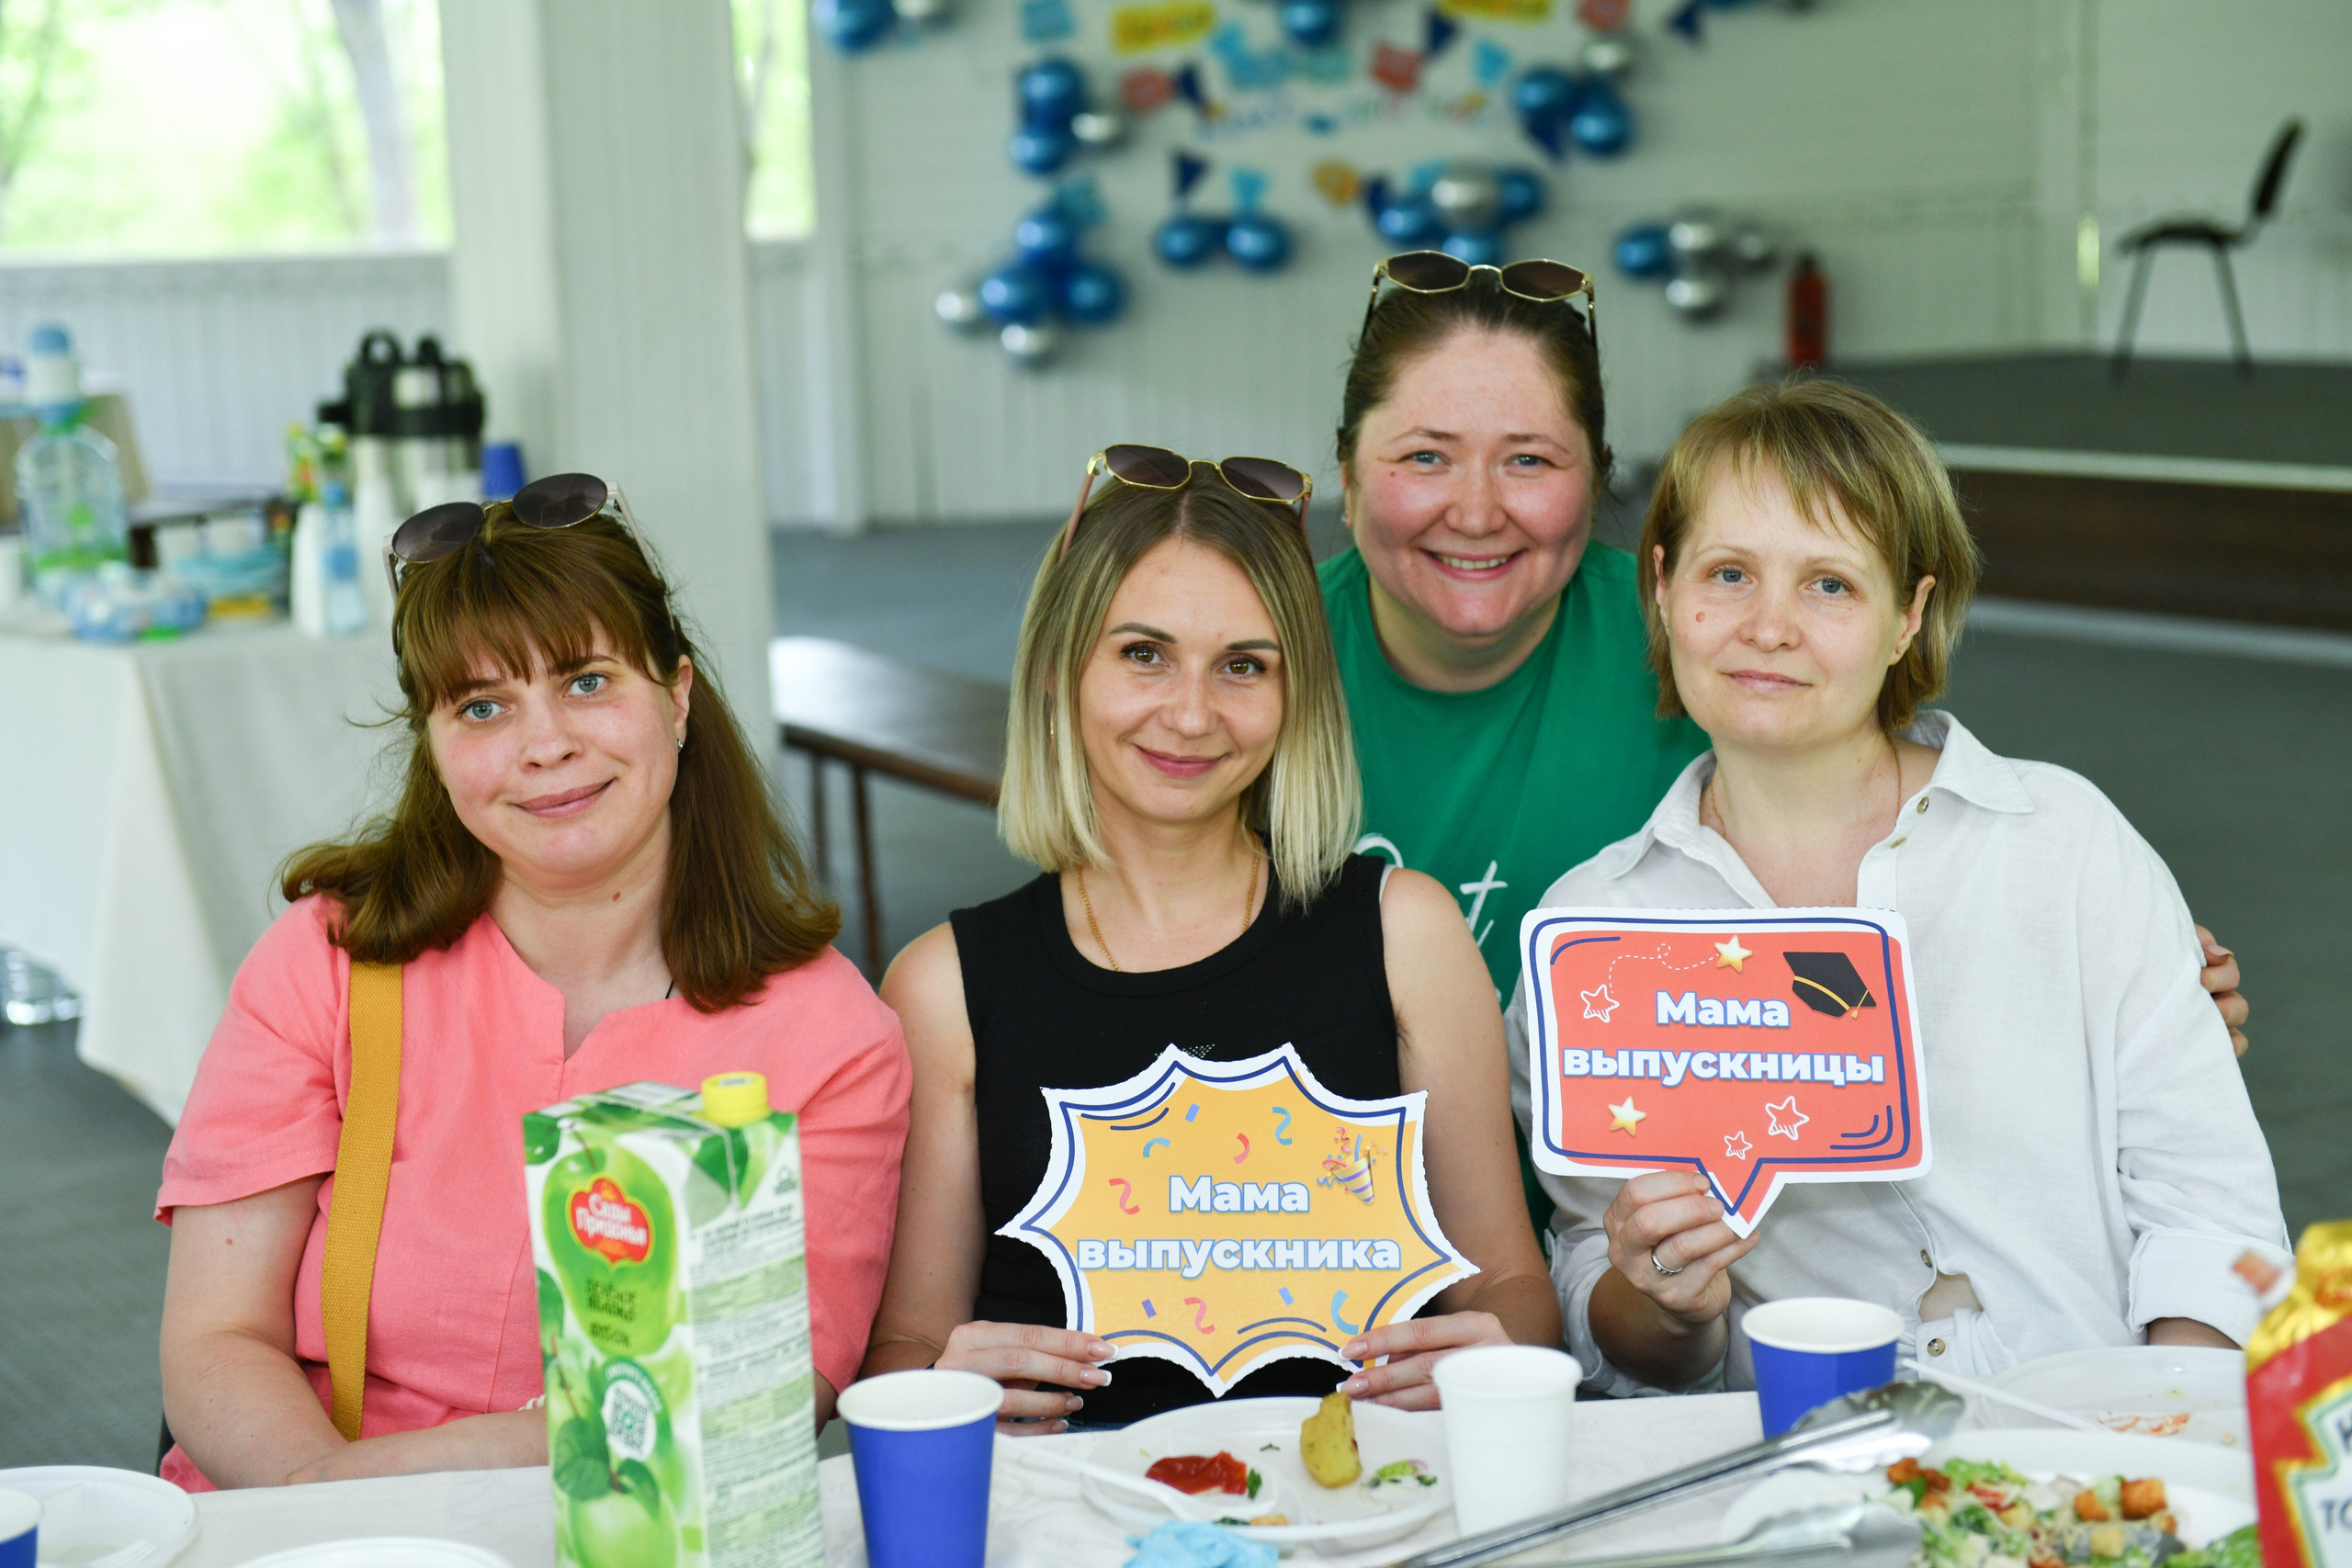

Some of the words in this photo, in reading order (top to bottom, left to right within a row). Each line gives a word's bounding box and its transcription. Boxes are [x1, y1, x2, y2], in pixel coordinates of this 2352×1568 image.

[1657, 990, 1791, 1028] Мама
[1563, 1048, 1885, 1087] выпускницы
[1169, 1175, 1310, 1213] Мама
[1078, 1239, 1402, 1279] выпускника
